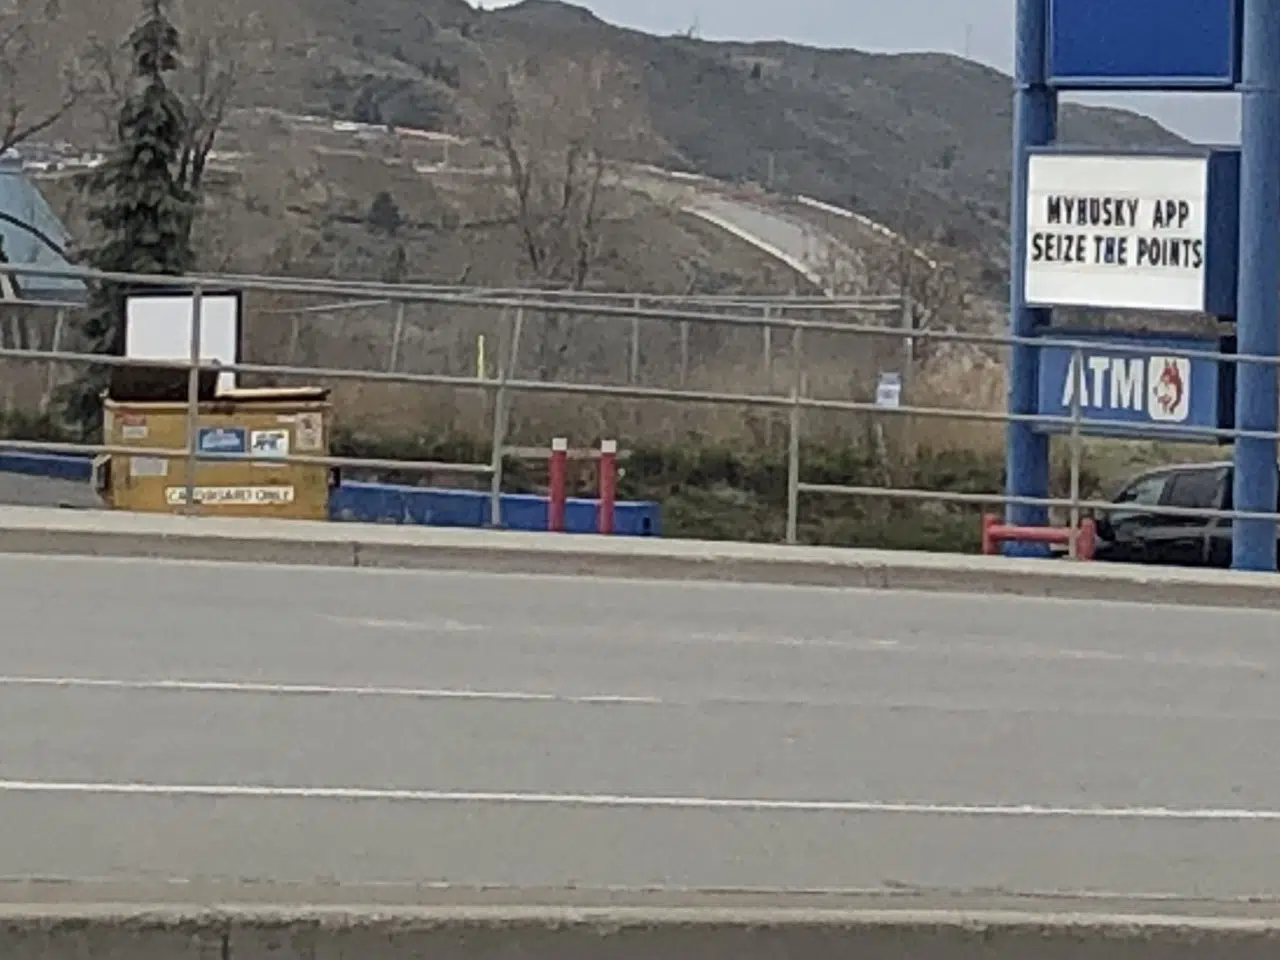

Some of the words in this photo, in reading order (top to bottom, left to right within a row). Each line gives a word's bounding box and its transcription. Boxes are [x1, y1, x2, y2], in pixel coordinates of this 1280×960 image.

[1047, 196, 1139, 227] MYHUSKY
[1153, 200, 1189, 228] APP
[1032, 233, 1086, 262] SEIZE
[1094, 236, 1127, 265] THE
[1136, 238, 1203, 269] POINTS
[1062, 356, 1144, 411] ATM
